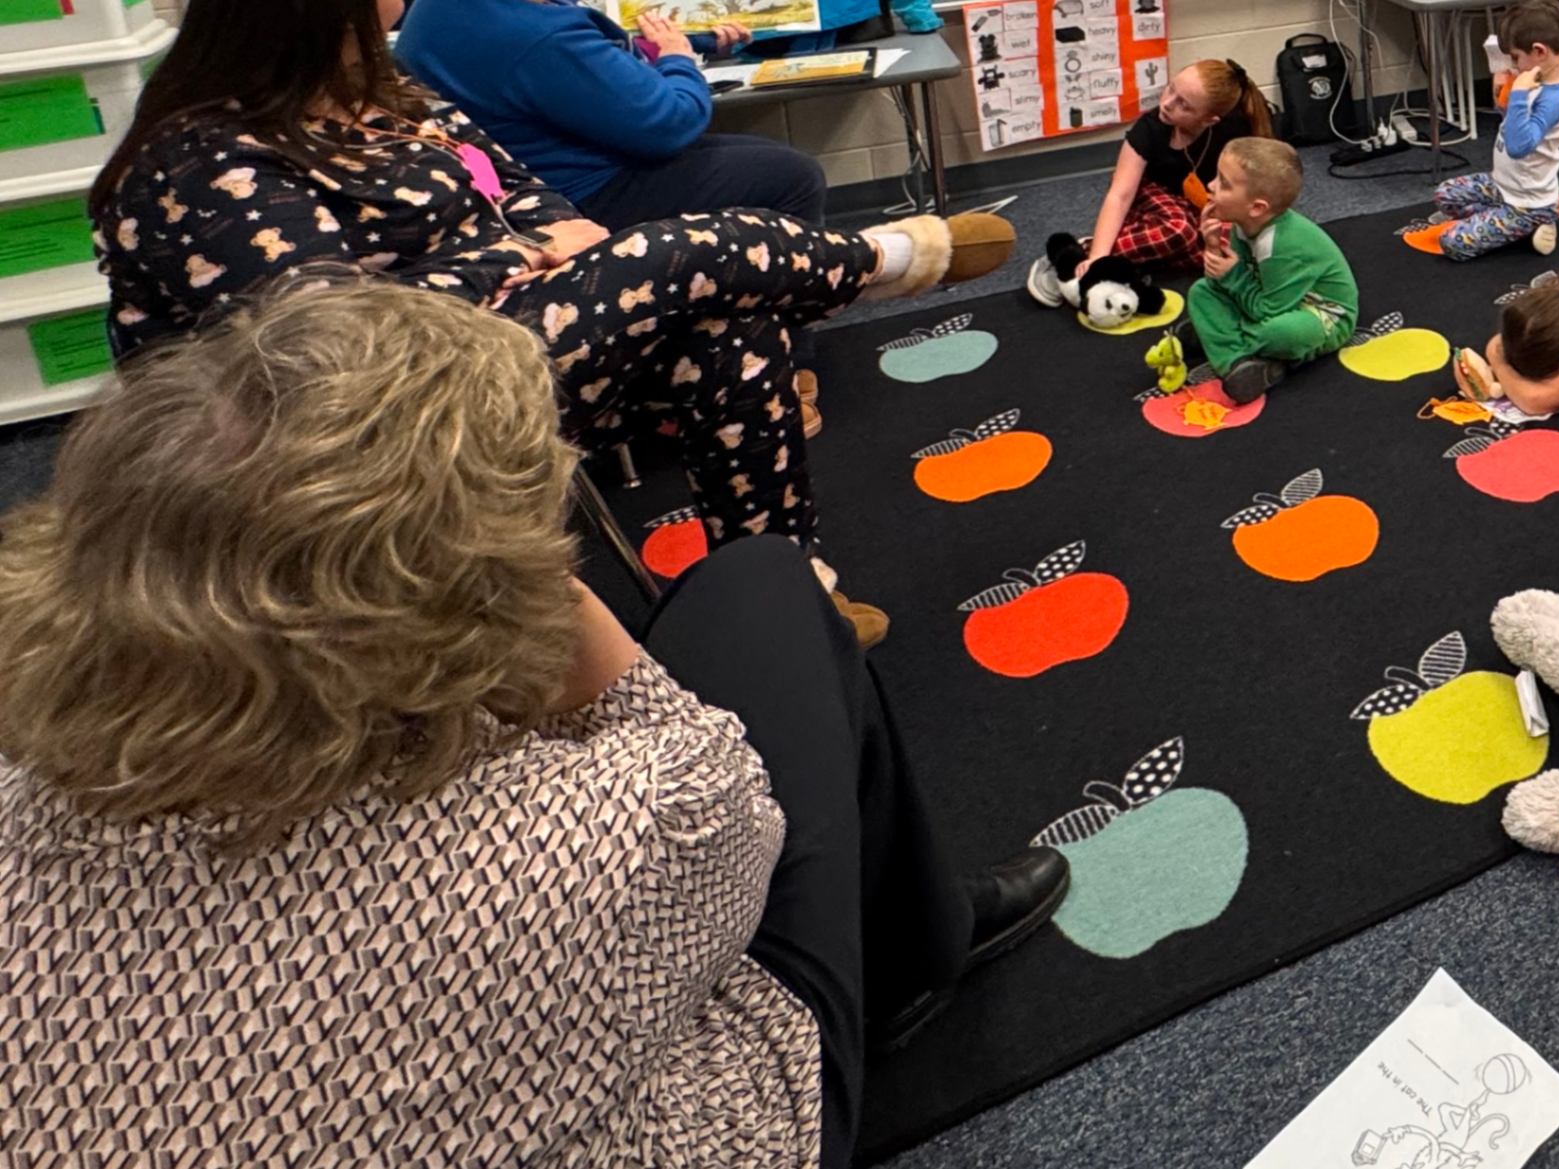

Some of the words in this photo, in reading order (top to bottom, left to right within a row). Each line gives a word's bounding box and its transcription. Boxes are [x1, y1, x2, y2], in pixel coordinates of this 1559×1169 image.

[1088, 26, 1116, 39] heavy
[1138, 22, 1160, 34] dirty
[1011, 39, 1031, 49] wet
[1092, 51, 1116, 64] shiny
[1008, 68, 1036, 81] scary
[1093, 75, 1120, 89] fluffy
[1015, 94, 1040, 106] slimy
[1090, 105, 1117, 119] smelly
[1011, 121, 1041, 135] empty
[1378, 1061, 1393, 1079] the
[1401, 1085, 1417, 1099] cat
[1417, 1097, 1432, 1118] The
